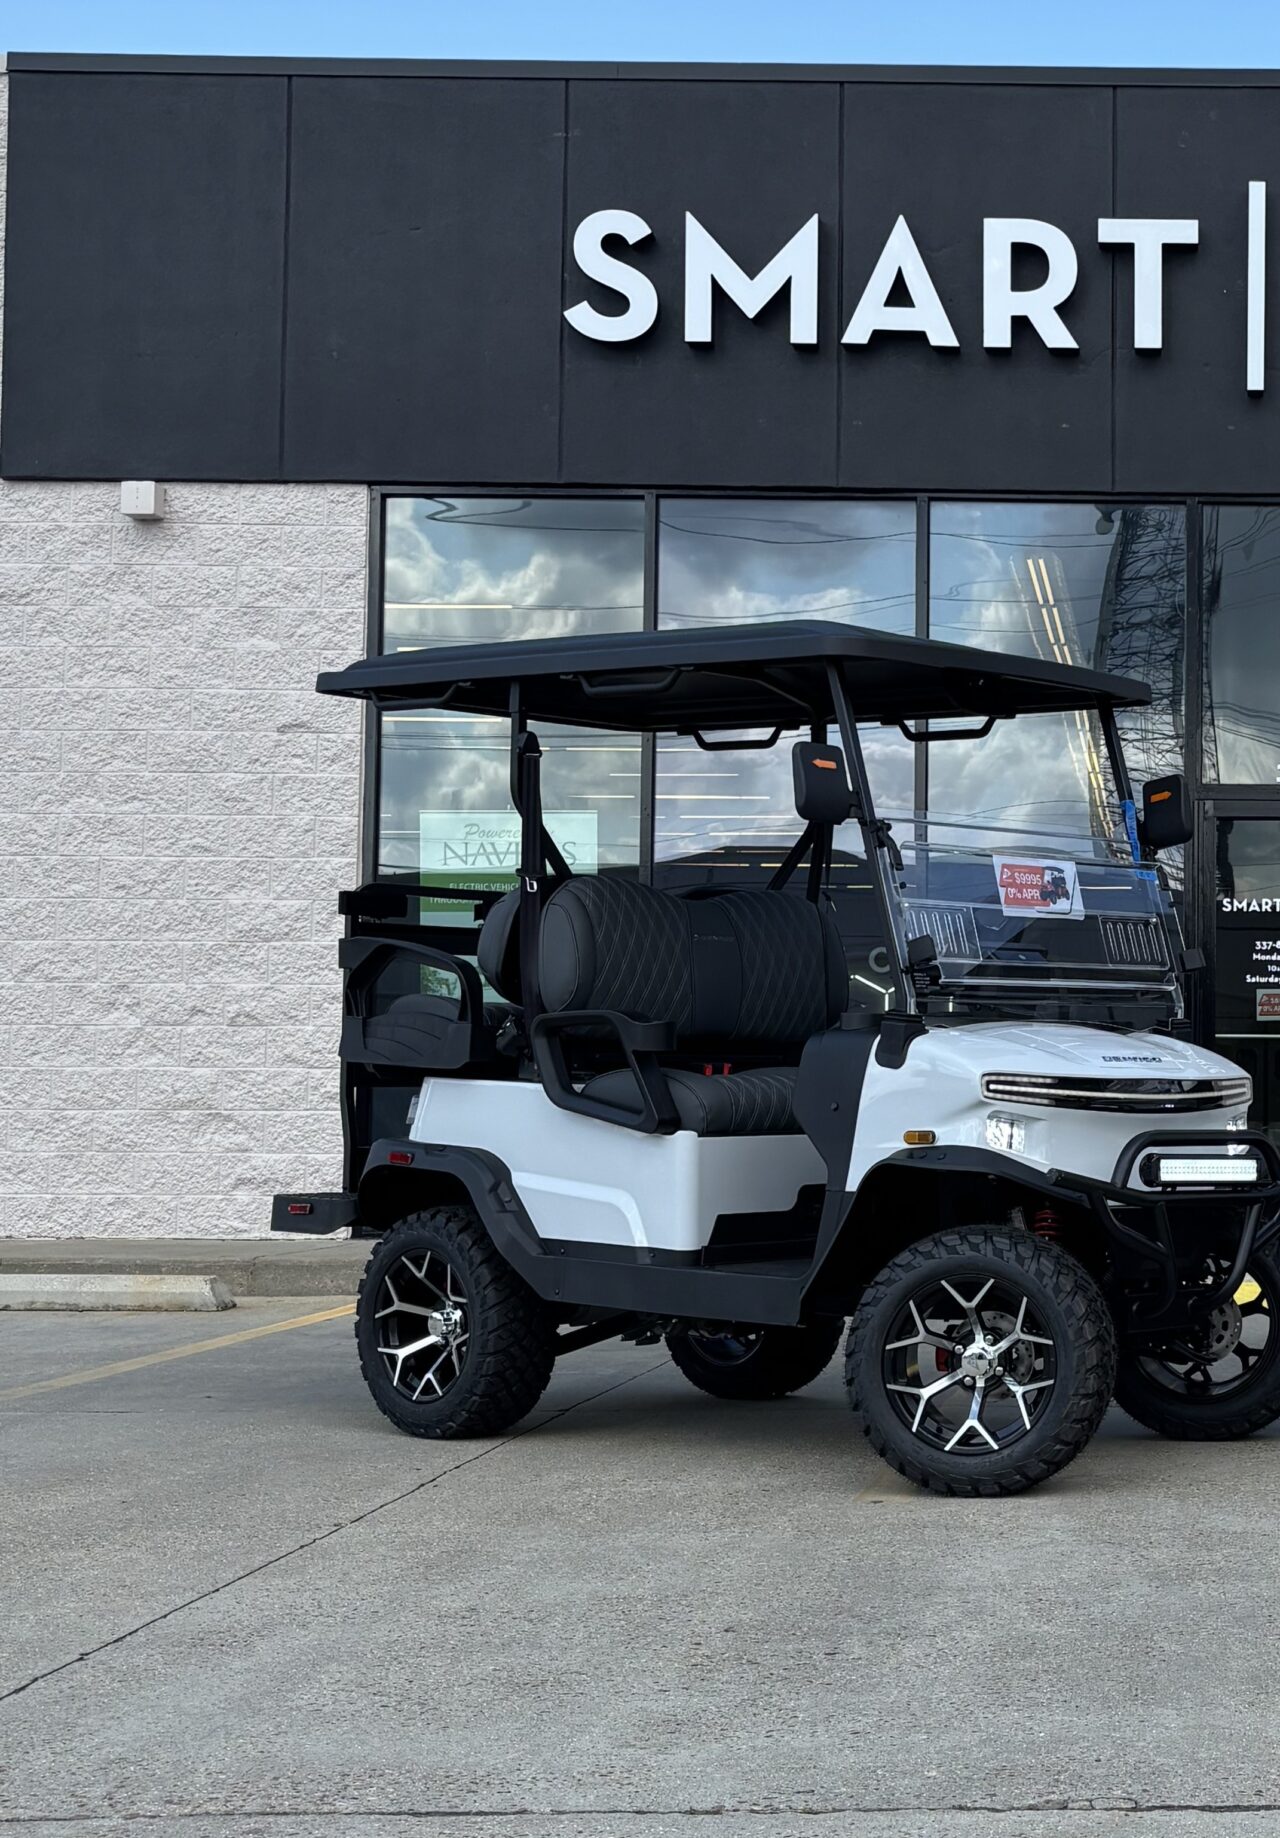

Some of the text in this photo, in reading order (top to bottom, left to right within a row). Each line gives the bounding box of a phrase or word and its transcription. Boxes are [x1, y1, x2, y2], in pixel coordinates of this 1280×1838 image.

[563, 208, 1199, 350] SMART
[464, 823, 521, 840] Powere
[442, 841, 577, 867] NAVIS
[1014, 872, 1042, 885] $9995
[1007, 887, 1041, 900] 0% APR
